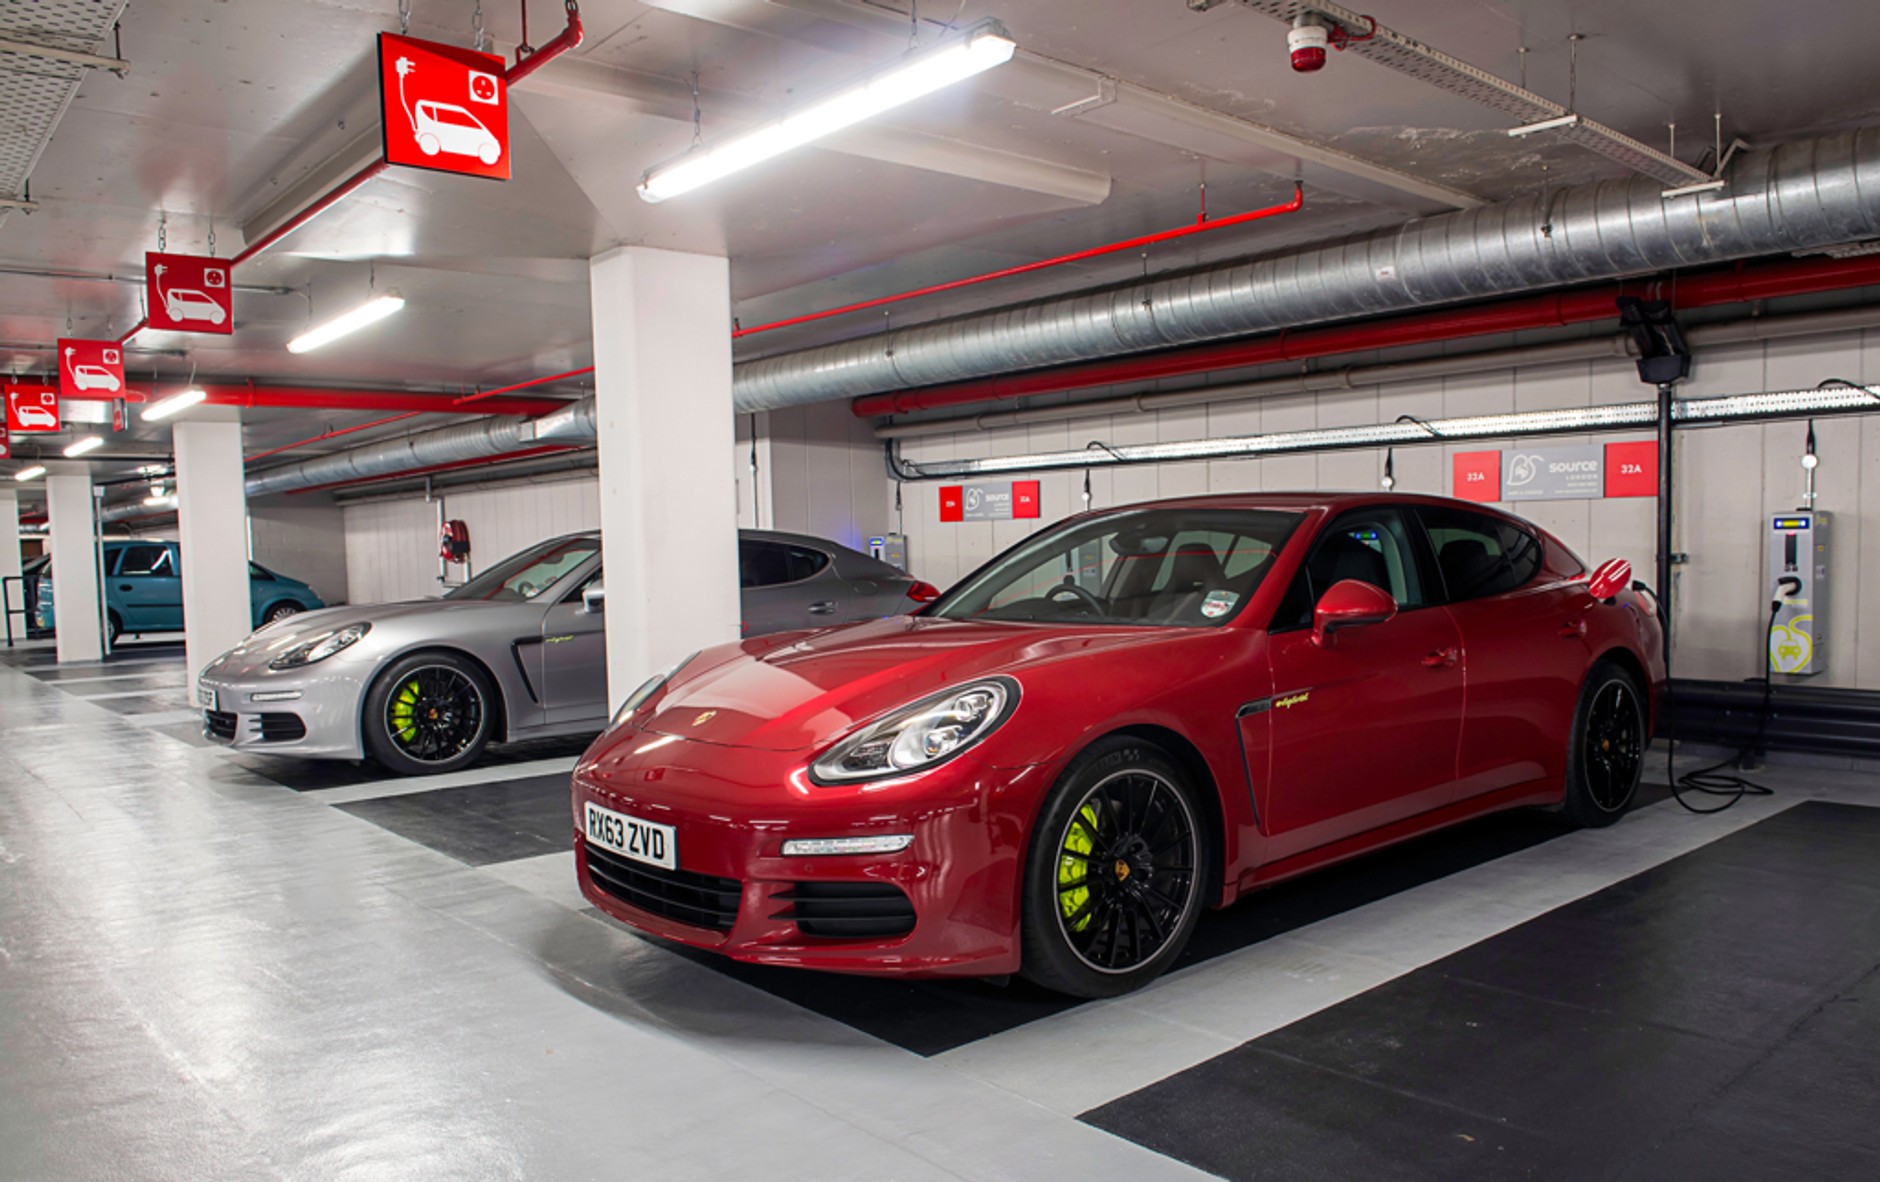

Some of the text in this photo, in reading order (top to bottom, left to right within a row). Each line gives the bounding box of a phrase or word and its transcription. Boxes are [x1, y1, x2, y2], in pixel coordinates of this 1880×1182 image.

[1549, 460, 1598, 473] source
[1621, 464, 1642, 474] 32A
[1466, 472, 1485, 482] 32A
[589, 807, 665, 860] RX63 ZVD
